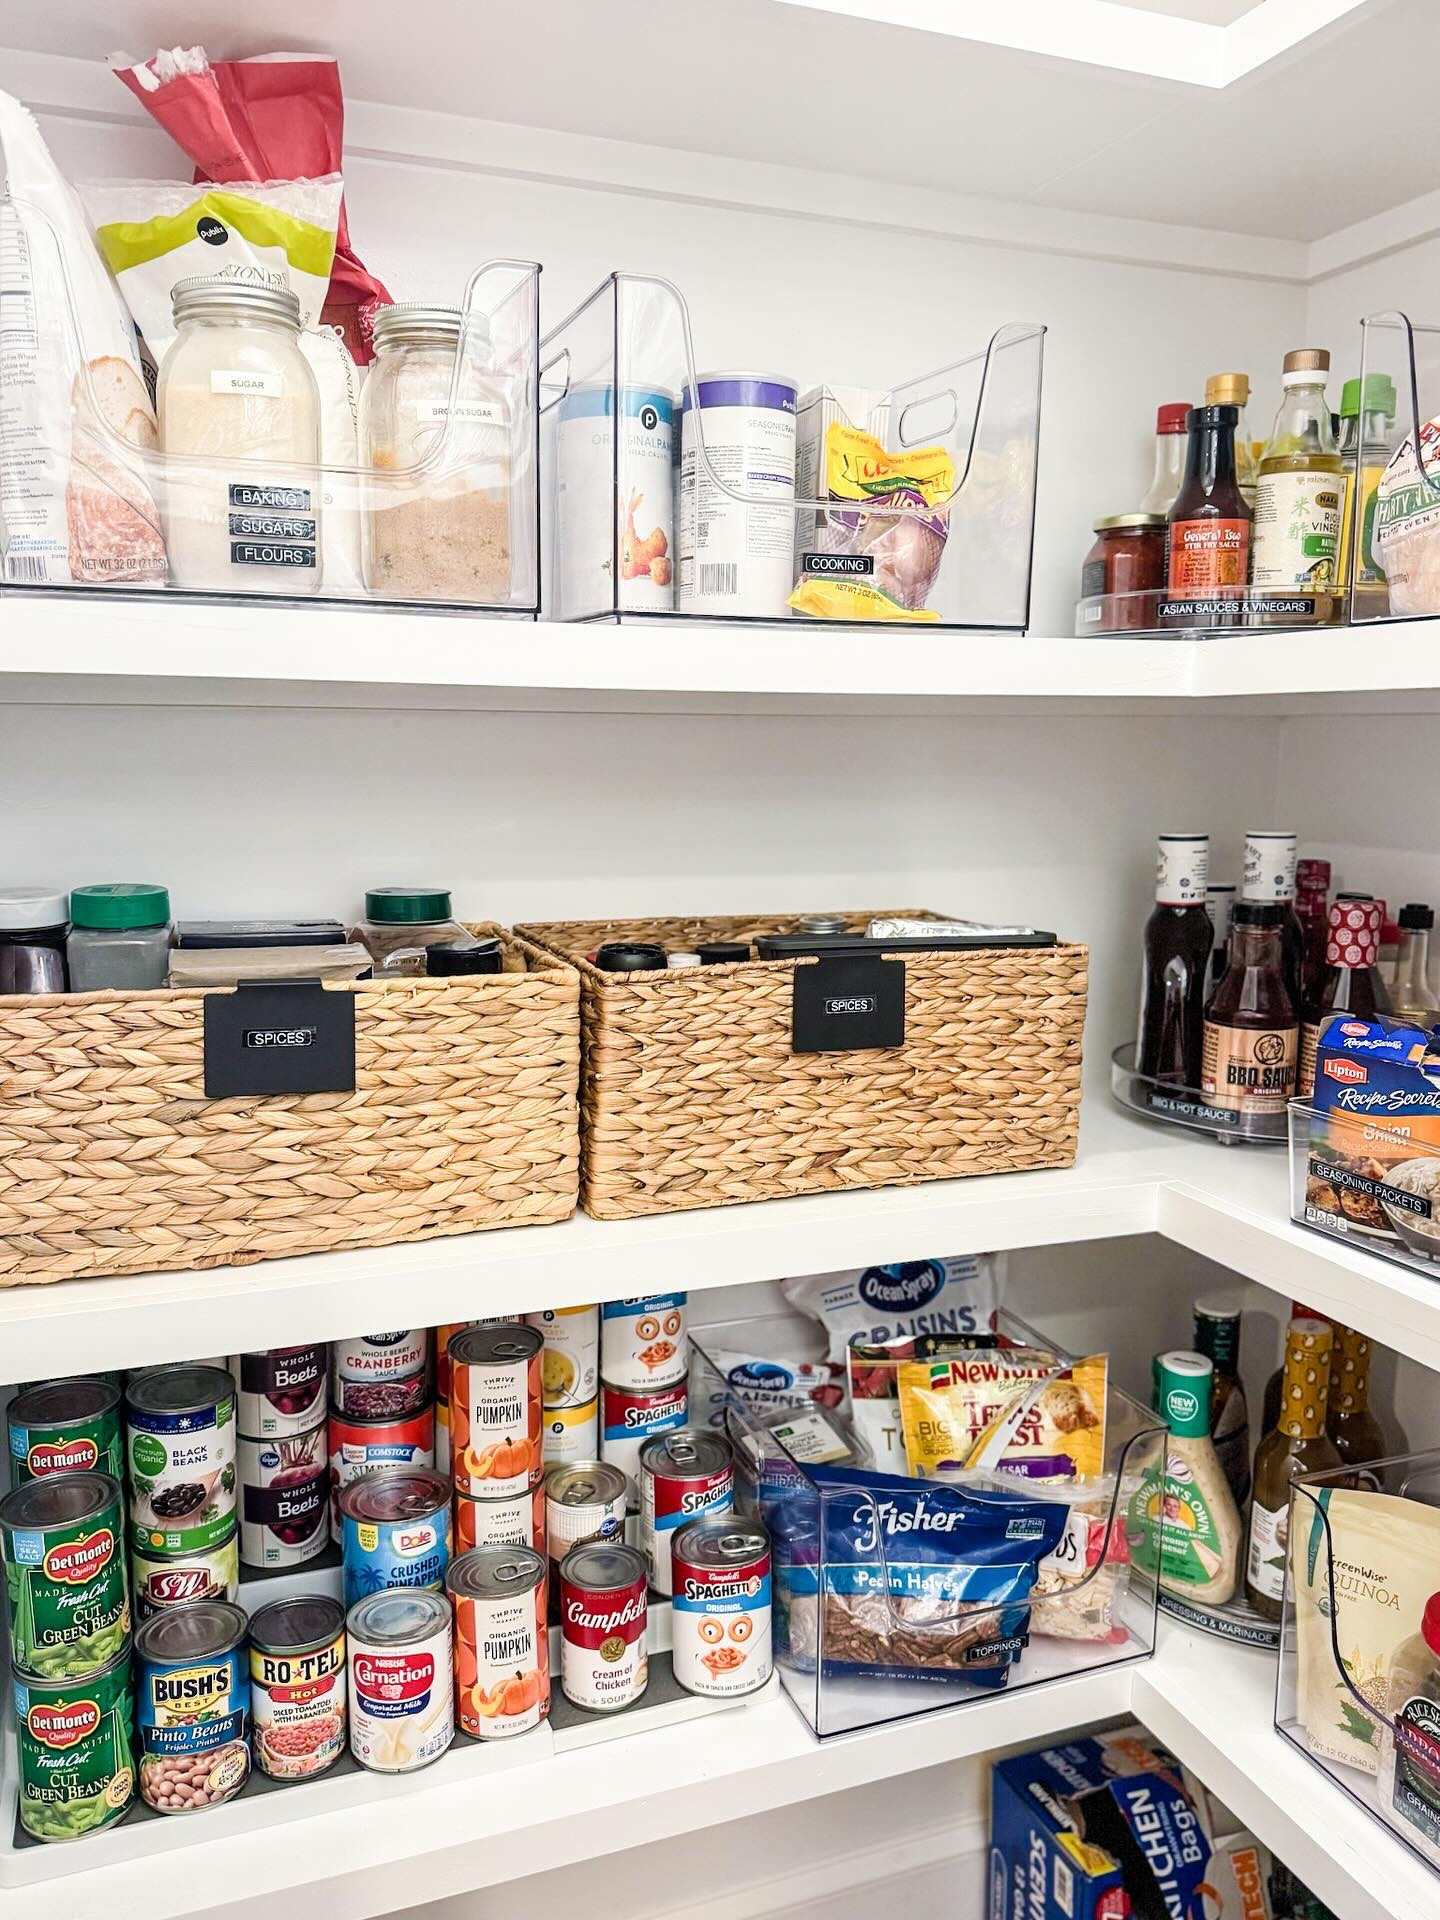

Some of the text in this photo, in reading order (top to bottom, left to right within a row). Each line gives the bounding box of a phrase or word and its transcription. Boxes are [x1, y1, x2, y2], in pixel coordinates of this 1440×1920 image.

[200, 225, 225, 239] Publix
[231, 379, 265, 390] SUGAR
[466, 408, 493, 418] SUGAR
[242, 491, 298, 506] BAKING
[241, 519, 304, 535] SUGARS
[1184, 529, 1221, 542] General
[1219, 541, 1240, 549] SAUCE
[245, 547, 303, 563] FLOURS
[81, 559, 98, 570] NET
[114, 558, 125, 570] 32
[126, 558, 137, 570] OZ
[811, 558, 864, 571] COOKING
[1162, 601, 1306, 616] ASIAN SAUCES & VINEGARS
[830, 999, 868, 1013] SPICES
[1341, 1023, 1369, 1036] Lipton
[254, 1031, 305, 1046] SPICES
[1227, 1065, 1257, 1086] BBQ
[1326, 1061, 1365, 1081] Lipton
[1337, 1087, 1393, 1112] Recipe
[1167, 1101, 1175, 1111] &
[1175, 1103, 1196, 1115] HOT
[1196, 1107, 1232, 1121] SAUCE
[1316, 1163, 1423, 1213] SEASONING PACKETS
[864, 1279, 902, 1301] Ocean
[902, 1267, 937, 1302] Spray
[644, 1299, 675, 1312] ORIGINAL
[279, 1352, 316, 1368] WHOLE
[346, 1348, 422, 1370] CRANBERRY
[361, 1346, 410, 1358] WHOLE BERRY
[275, 1365, 319, 1388] Beets
[374, 1368, 399, 1377] SAUCE
[732, 1372, 759, 1387] Ocean
[951, 1361, 999, 1386] New
[483, 1376, 517, 1386] THRIVE
[481, 1395, 518, 1405] ORGANIC
[1170, 1395, 1195, 1408] NEW
[476, 1402, 523, 1424] PUMPKIN
[626, 1396, 687, 1427] SPAGHETTIO
[646, 1421, 676, 1434] ORIGINAL
[918, 1420, 951, 1436] BIG
[32, 1448, 95, 1469] Del Monte
[134, 1452, 164, 1464] organic
[172, 1445, 208, 1458] BLACK
[367, 1448, 412, 1457] COMSTOCK
[172, 1454, 208, 1467] BEANS
[997, 1464, 1029, 1476] AESAR
[282, 1482, 318, 1499] WHOLE
[277, 1495, 320, 1519] Beets
[1135, 1482, 1210, 1535] NEWMAN'S OWN
[490, 1510, 521, 1521] THRIVE
[488, 1528, 524, 1539] ORGANIC
[852, 1500, 965, 1552] Fisher
[400, 1531, 431, 1548] Dole
[20, 1547, 38, 1555] SEA
[49, 1538, 111, 1571] Del Monte
[70, 1562, 98, 1577] Quality
[390, 1555, 440, 1579] CRUSHED
[1329, 1554, 1387, 1583] reenWise
[386, 1566, 444, 1588] PINEAPPLE
[708, 1571, 740, 1582] Campbell's
[855, 1570, 902, 1589] Pecan
[34, 1586, 68, 1598] MADE
[1323, 1570, 1400, 1612] QUINOA
[56, 1591, 89, 1611] Fresh
[705, 1602, 743, 1612] ORIGINAL
[72, 1603, 102, 1625] CUT
[490, 1607, 524, 1620] THRIVE
[1160, 1596, 1273, 1644] DRESSING & MARINADE
[43, 1622, 89, 1644] GREEN
[91, 1600, 124, 1632] BEANS
[488, 1626, 527, 1639] ORGANIC
[483, 1634, 532, 1660] PUMPKIN
[974, 1637, 1023, 1657] TOPPINGS
[354, 1660, 433, 1687] Carnation
[592, 1663, 633, 1680] Cream of
[154, 1667, 230, 1701] BUSH'S
[595, 1676, 631, 1691] Chicken
[288, 1688, 318, 1701] Hot
[600, 1693, 626, 1705] SOUP
[174, 1697, 210, 1710] BEST
[273, 1699, 333, 1718] DICED TOMATOES
[363, 1699, 423, 1713] Evaporated Milk
[32, 1709, 97, 1730] Del Monte
[273, 1706, 334, 1724] WITH HABANEROS
[48, 1730, 77, 1742] Quality
[151, 1718, 234, 1743] Pinto Beans
[22, 1732, 112, 1755] MADE WITH
[164, 1737, 220, 1752] Frijoles Pintos
[36, 1754, 65, 1769] Fresh
[1326, 1746, 1336, 1755] 12
[1337, 1751, 1348, 1761] OZ
[27, 1774, 111, 1801] GREEN BEANS
[49, 1772, 80, 1789] CUT
[1170, 1799, 1203, 1863] Bags
